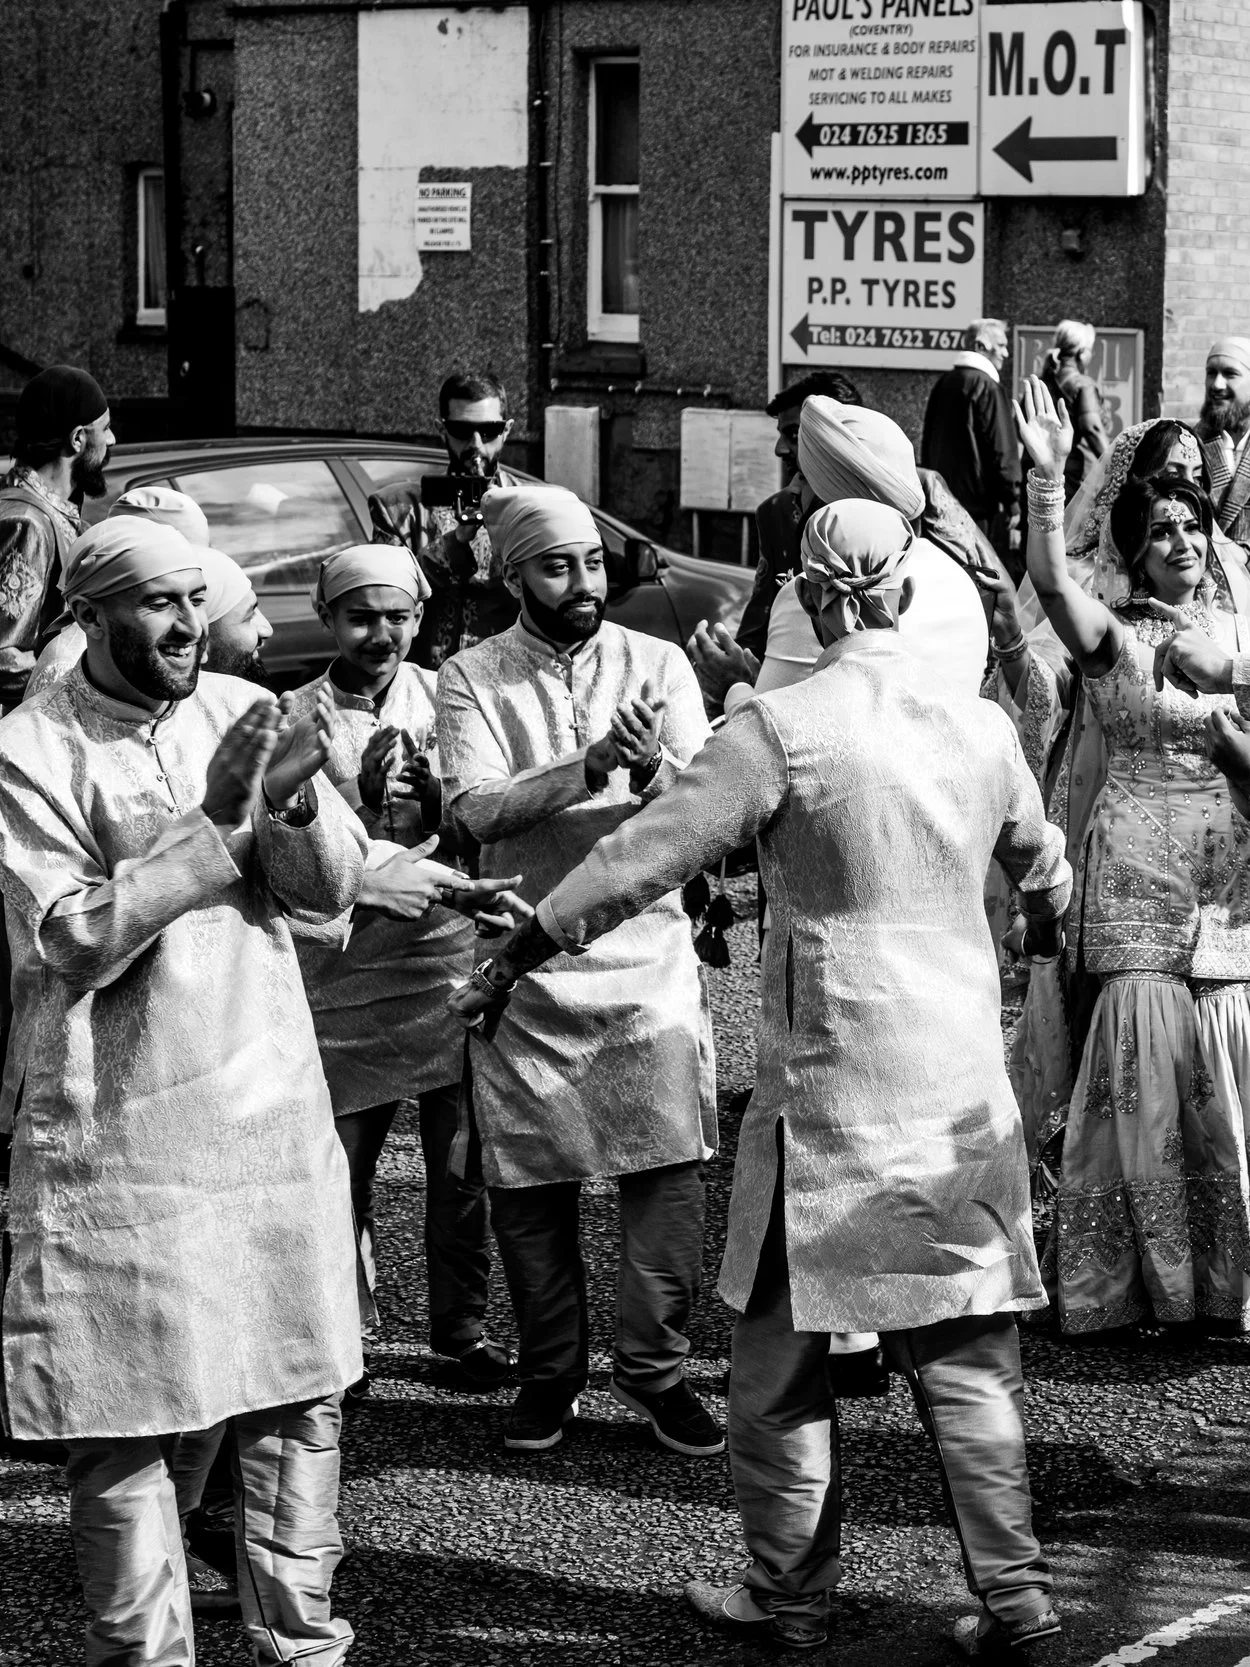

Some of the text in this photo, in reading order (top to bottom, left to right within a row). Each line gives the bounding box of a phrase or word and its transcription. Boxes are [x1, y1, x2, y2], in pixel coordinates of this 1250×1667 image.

[792, 0, 974, 21] PAULS PANELS
[849, 24, 914, 38] (COVENTRY)
[788, 39, 976, 58] FOR INSURANCE & BODY REPAIRS
[988, 28, 1126, 96] M.O.T
[808, 65, 953, 81] MOT & WELDING REPAIRS
[808, 89, 953, 106] SERVICING TO ALL MAKES
[819, 124, 948, 145] 024 7625 1365
[810, 165, 948, 186] www.pptyres.com
[419, 187, 466, 197] NO PARKING
[792, 209, 976, 264] TYRES
[808, 276, 956, 309] P.P. TYRES
[809, 327, 841, 344] Tel:
[845, 328, 876, 346] 024
[881, 329, 924, 347] 7622
